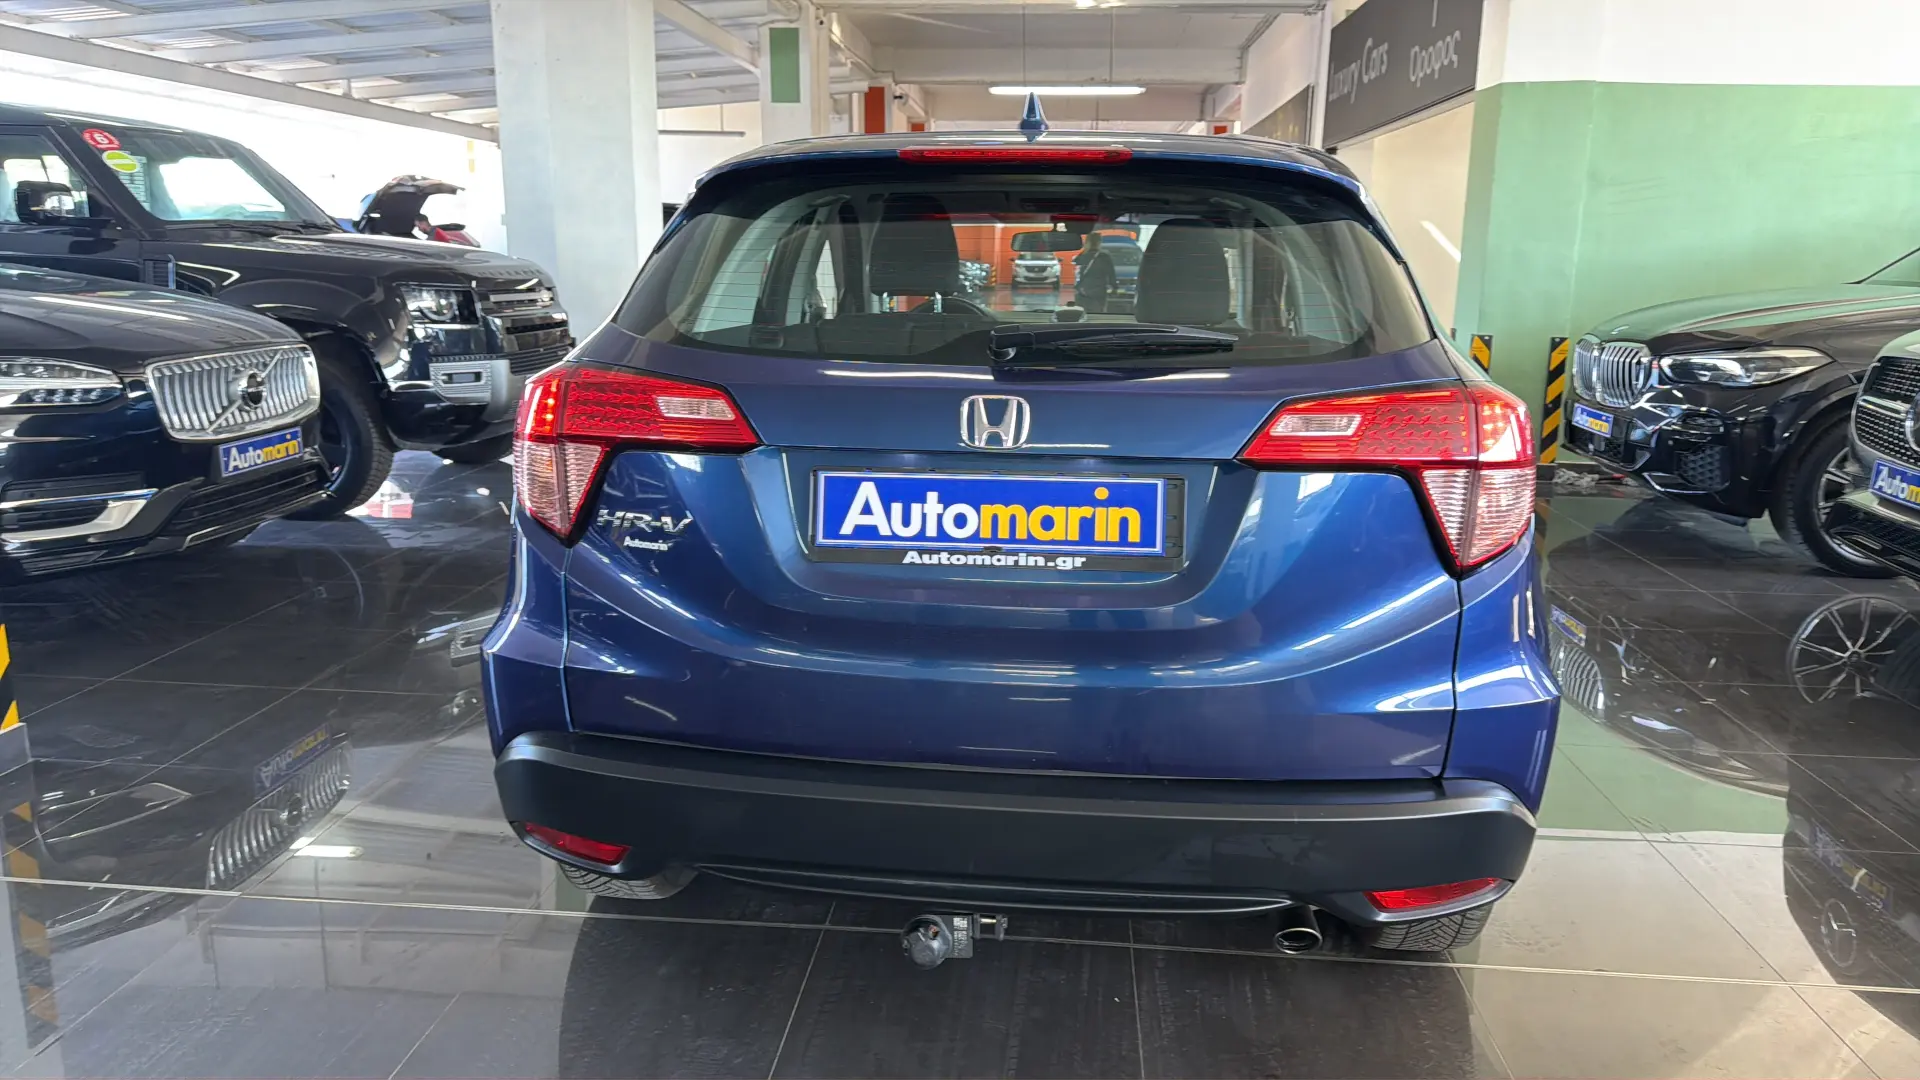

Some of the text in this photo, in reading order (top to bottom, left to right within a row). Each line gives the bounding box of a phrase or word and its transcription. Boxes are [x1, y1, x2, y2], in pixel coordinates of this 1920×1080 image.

[1327, 37, 1389, 104] Luxury Cars
[228, 433, 299, 472] Automarin
[597, 509, 694, 533] HR-V
[839, 481, 1141, 543] Automarin
[902, 550, 1087, 570] Automarin.gr
